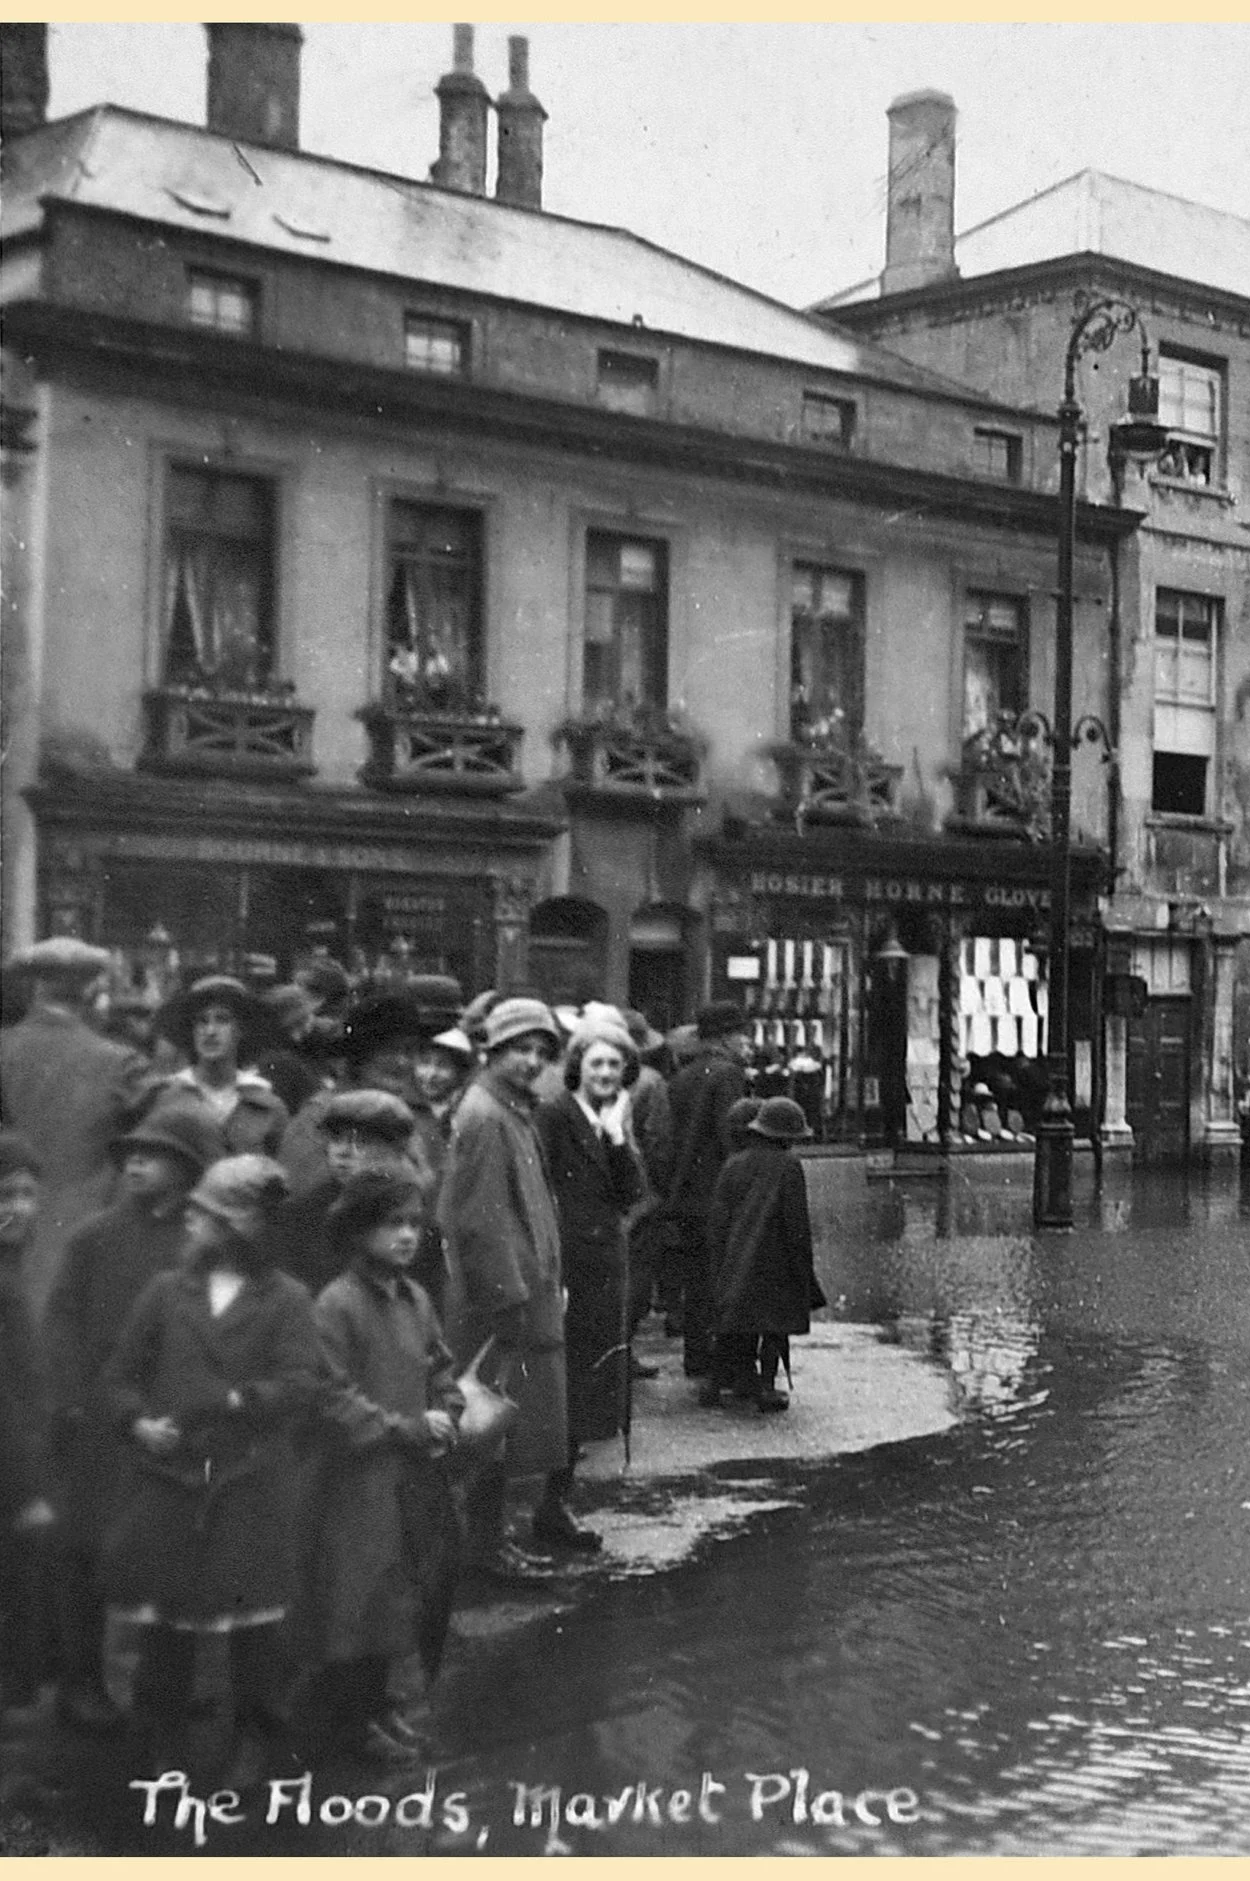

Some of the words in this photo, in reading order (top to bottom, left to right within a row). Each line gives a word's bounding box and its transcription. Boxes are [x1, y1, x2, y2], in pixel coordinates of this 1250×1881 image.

[751, 871, 844, 898] HOSIER
[865, 877, 965, 904] HORNE
[984, 886, 1051, 908] GLOVE
